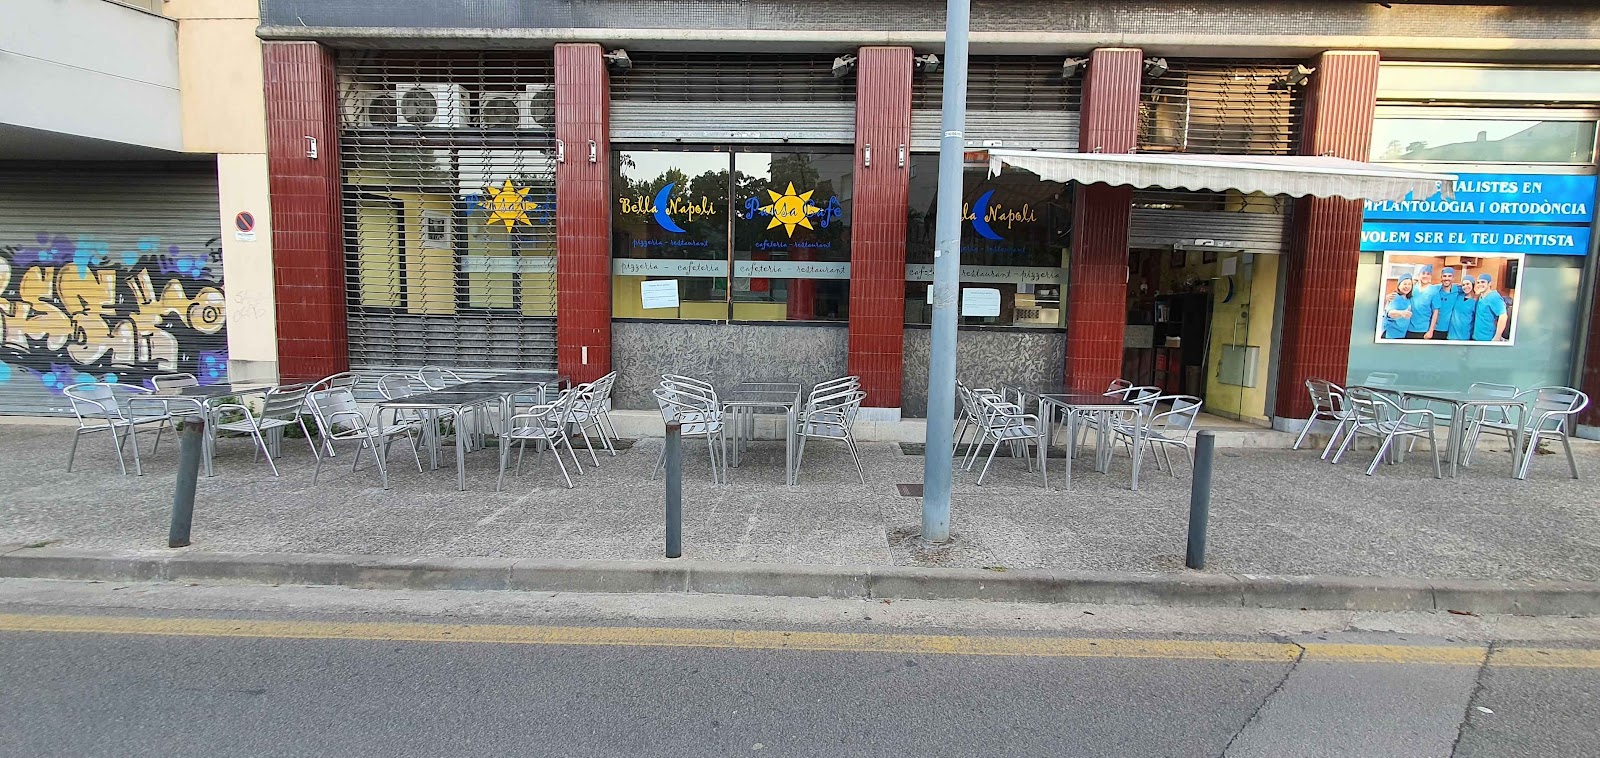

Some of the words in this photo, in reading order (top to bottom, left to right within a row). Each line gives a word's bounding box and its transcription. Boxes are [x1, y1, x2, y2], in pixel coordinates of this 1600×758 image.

[1522, 182, 1542, 194] EN
[619, 195, 659, 214] Bella
[665, 195, 717, 222] Napoli
[1363, 199, 1475, 213] MPLANTOLOGIA
[1479, 201, 1486, 213] I
[1489, 199, 1587, 215] ORTODÒNCIA
[984, 202, 1037, 229] Napoli
[754, 239, 788, 251] cafeteria
[794, 241, 832, 249] restaurant
[1360, 230, 1411, 243] VOLEM
[1414, 231, 1444, 244] SER
[1448, 232, 1467, 244] EL
[1471, 232, 1500, 245] TEU
[1503, 233, 1575, 247] DENTISTA
[620, 262, 659, 274] pizzeria
[677, 261, 720, 275] cafeteria
[739, 262, 782, 276] cafeteria
[796, 265, 846, 275] restaurant
[961, 269, 1012, 279] restaurant
[1019, 270, 1060, 281] pizzeria
